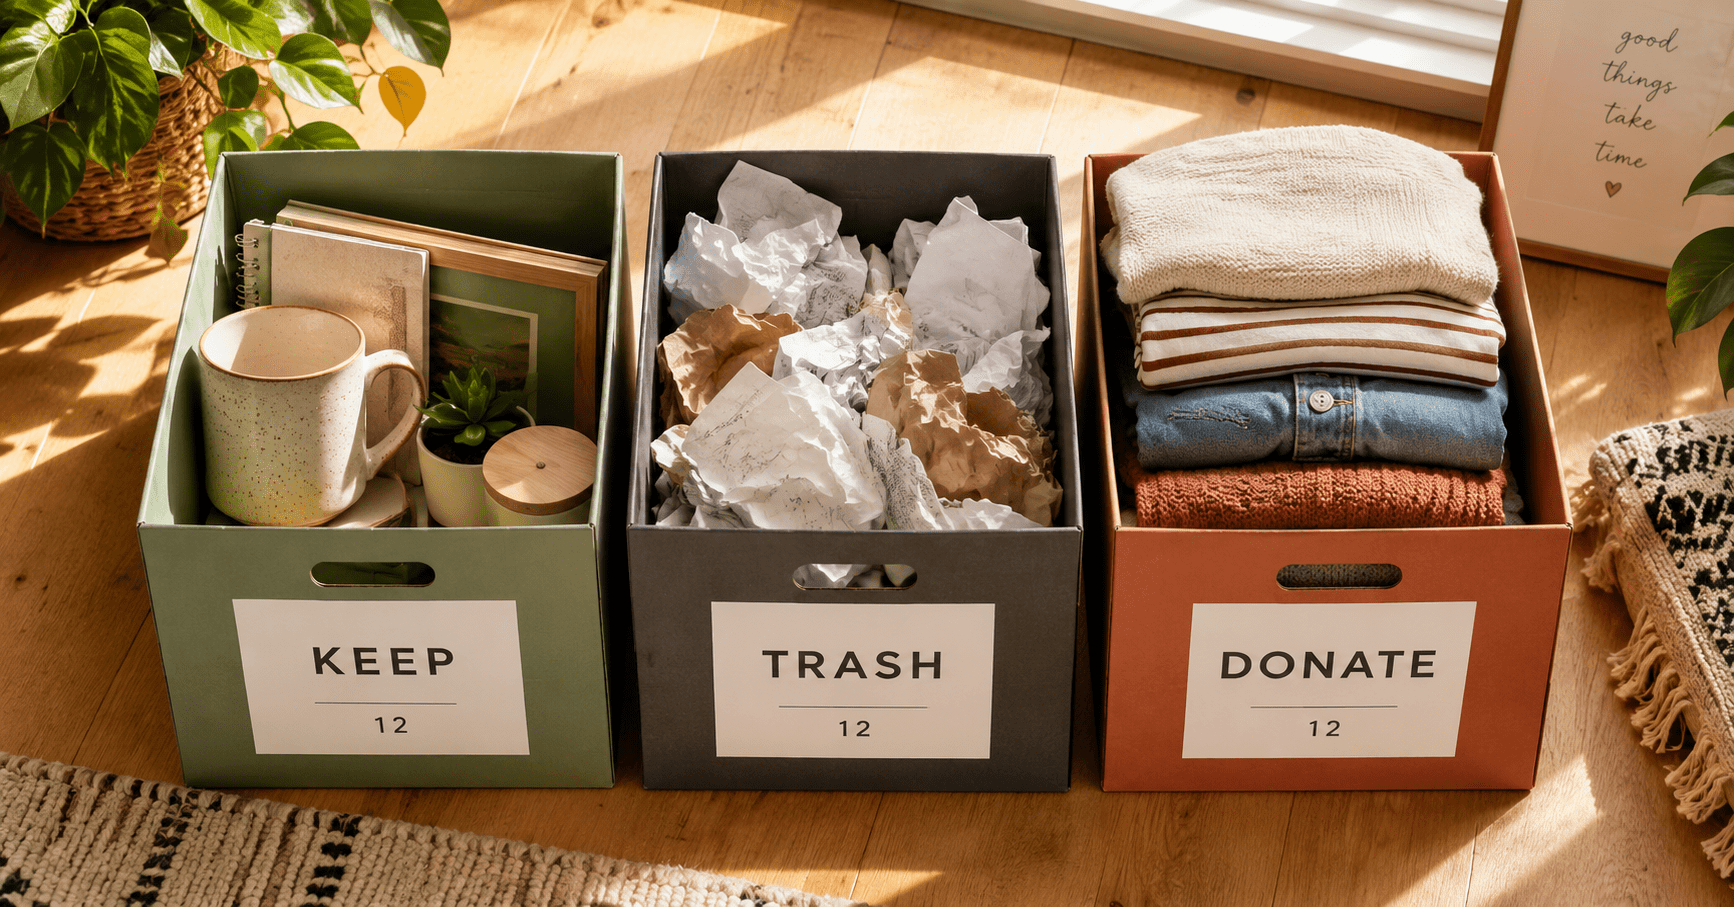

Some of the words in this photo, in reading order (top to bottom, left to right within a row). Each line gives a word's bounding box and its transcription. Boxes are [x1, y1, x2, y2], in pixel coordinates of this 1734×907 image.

[1615, 28, 1679, 54] good
[1602, 60, 1677, 102] things
[1604, 102, 1656, 131] take
[1595, 140, 1647, 169] time
[312, 646, 455, 676] KEEP
[761, 649, 943, 680] TRASH
[1220, 649, 1438, 680] DONATE
[374, 716, 408, 734] 12
[838, 720, 871, 738] 12
[1309, 719, 1342, 737] 12
